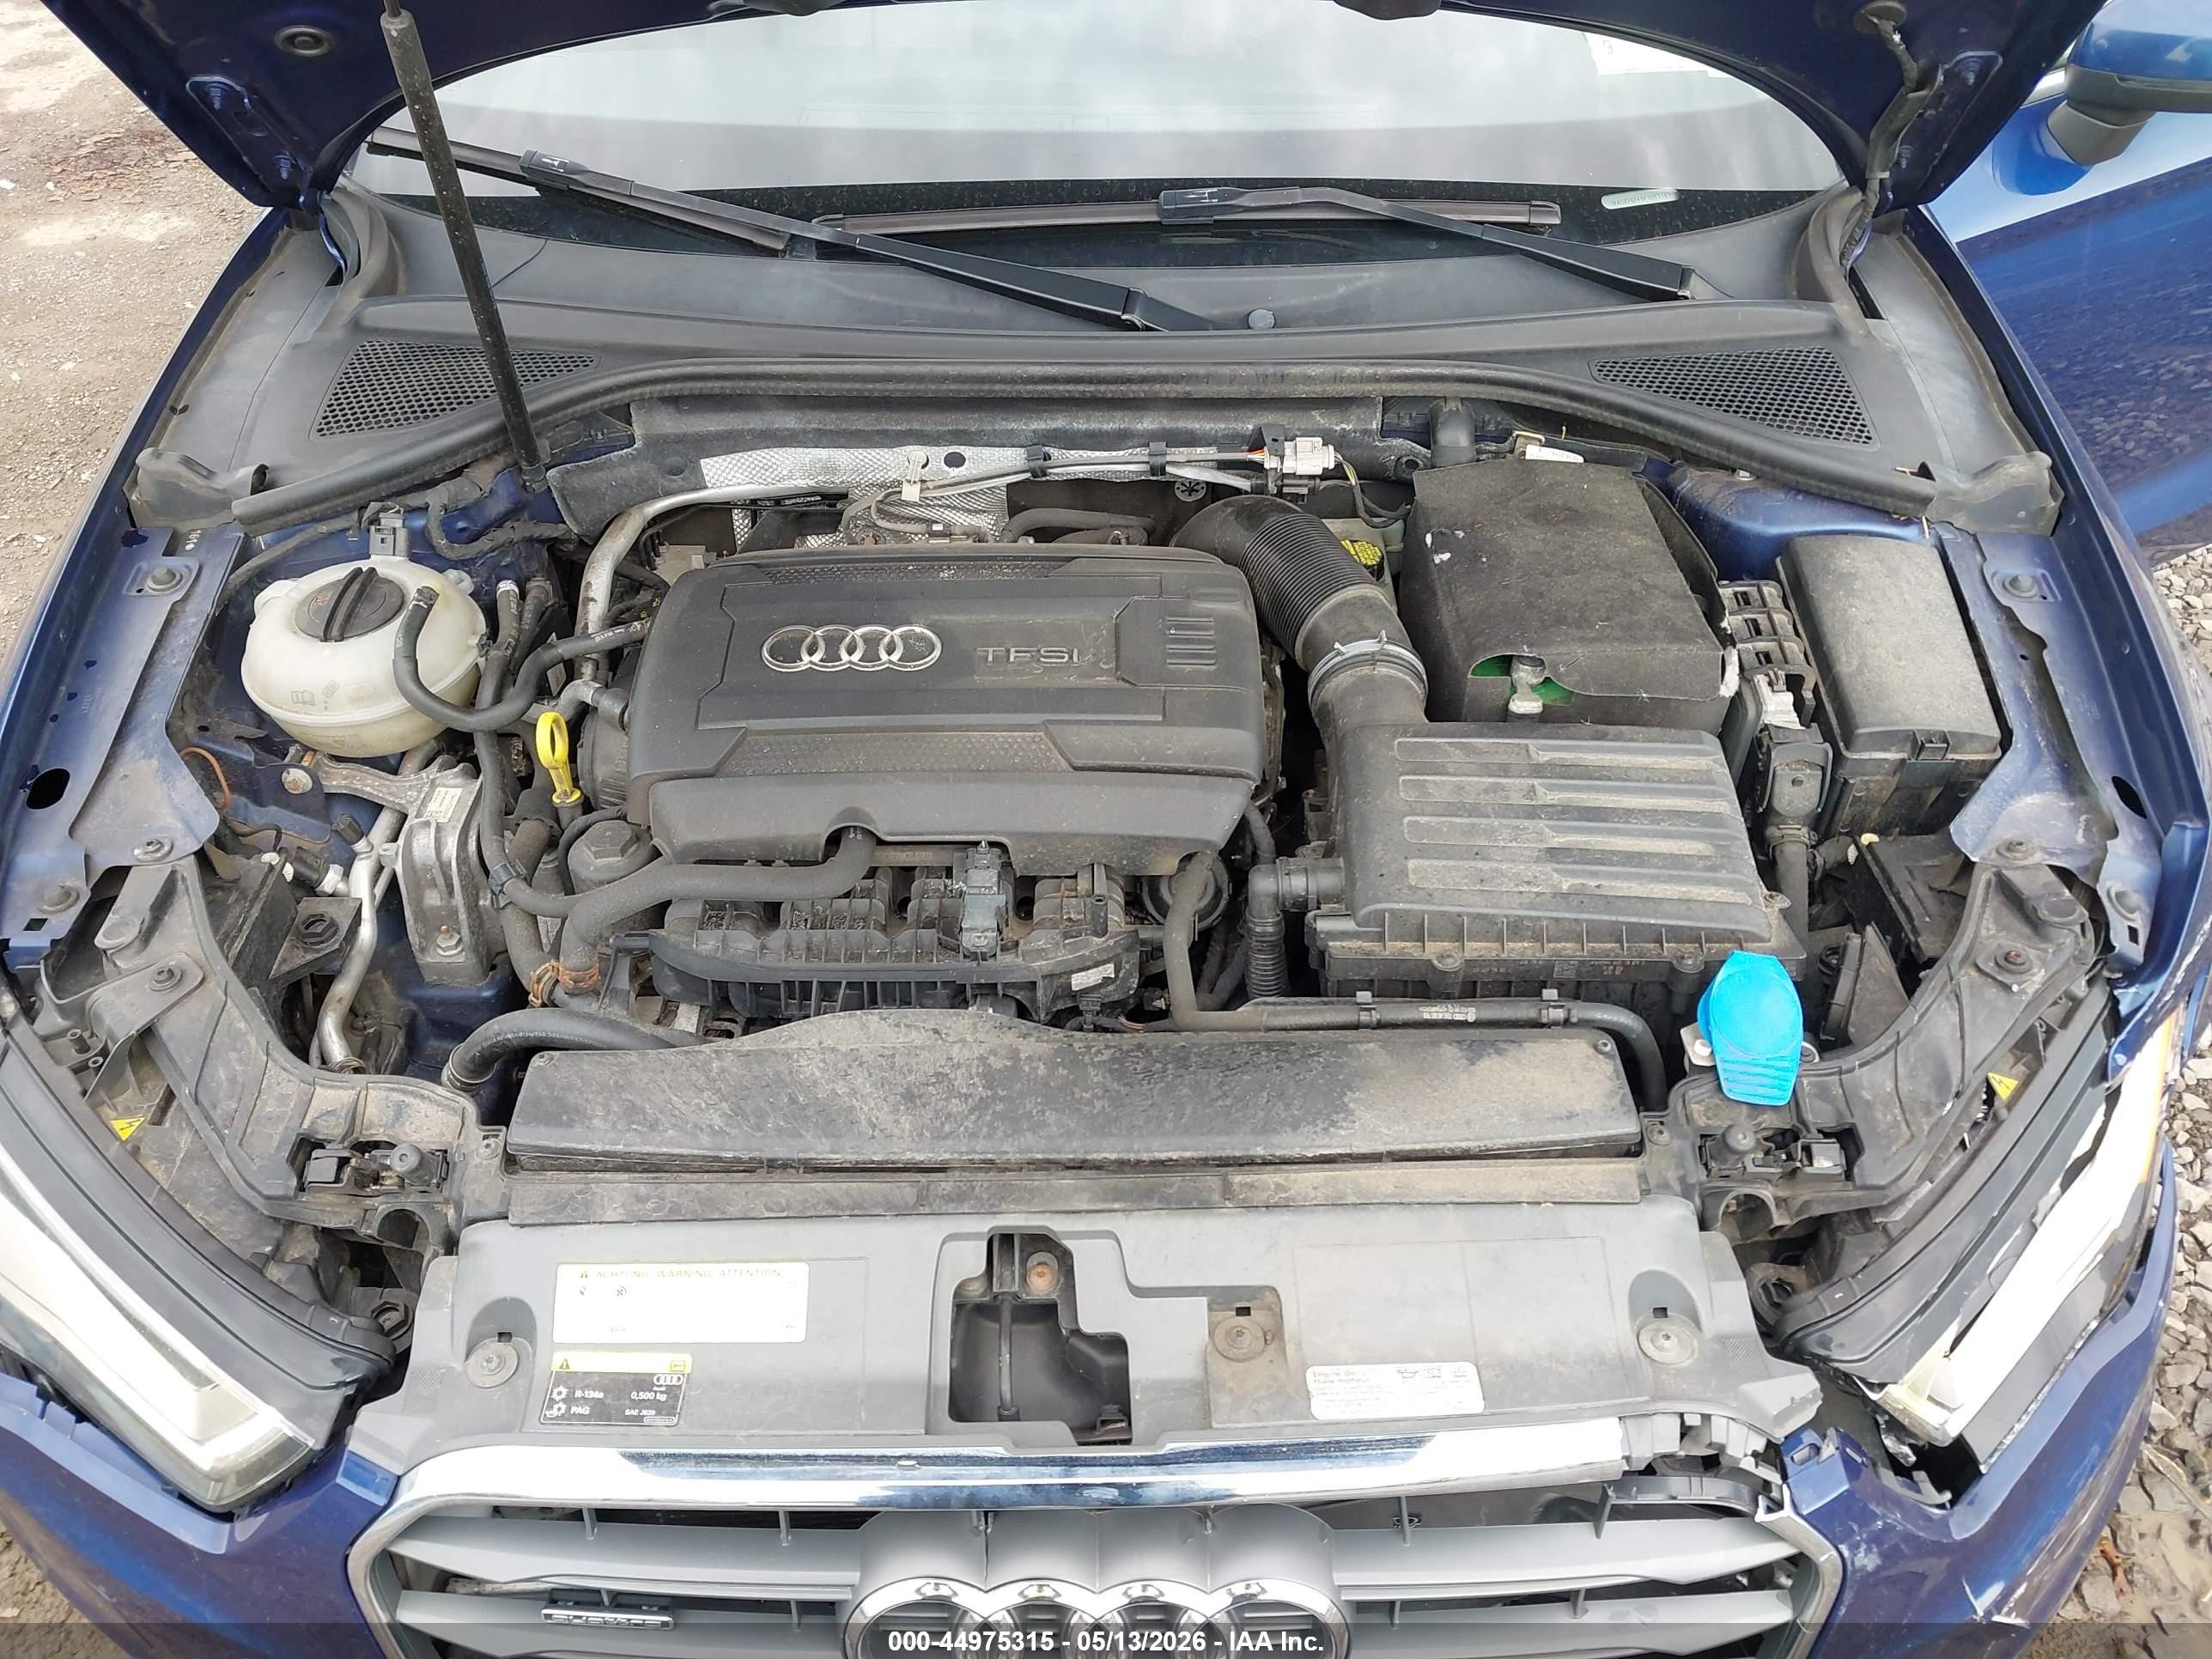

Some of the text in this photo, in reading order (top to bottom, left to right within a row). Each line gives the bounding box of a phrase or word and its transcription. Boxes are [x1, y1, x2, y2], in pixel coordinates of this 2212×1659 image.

[976, 647, 1079, 664] TFSI
[595, 1270, 649, 1279] ACHTUNG
[719, 1269, 781, 1278] ATTENTION
[630, 1391, 654, 1401] 0,500
[656, 1390, 667, 1401] kg
[570, 1406, 591, 1415] PAG
